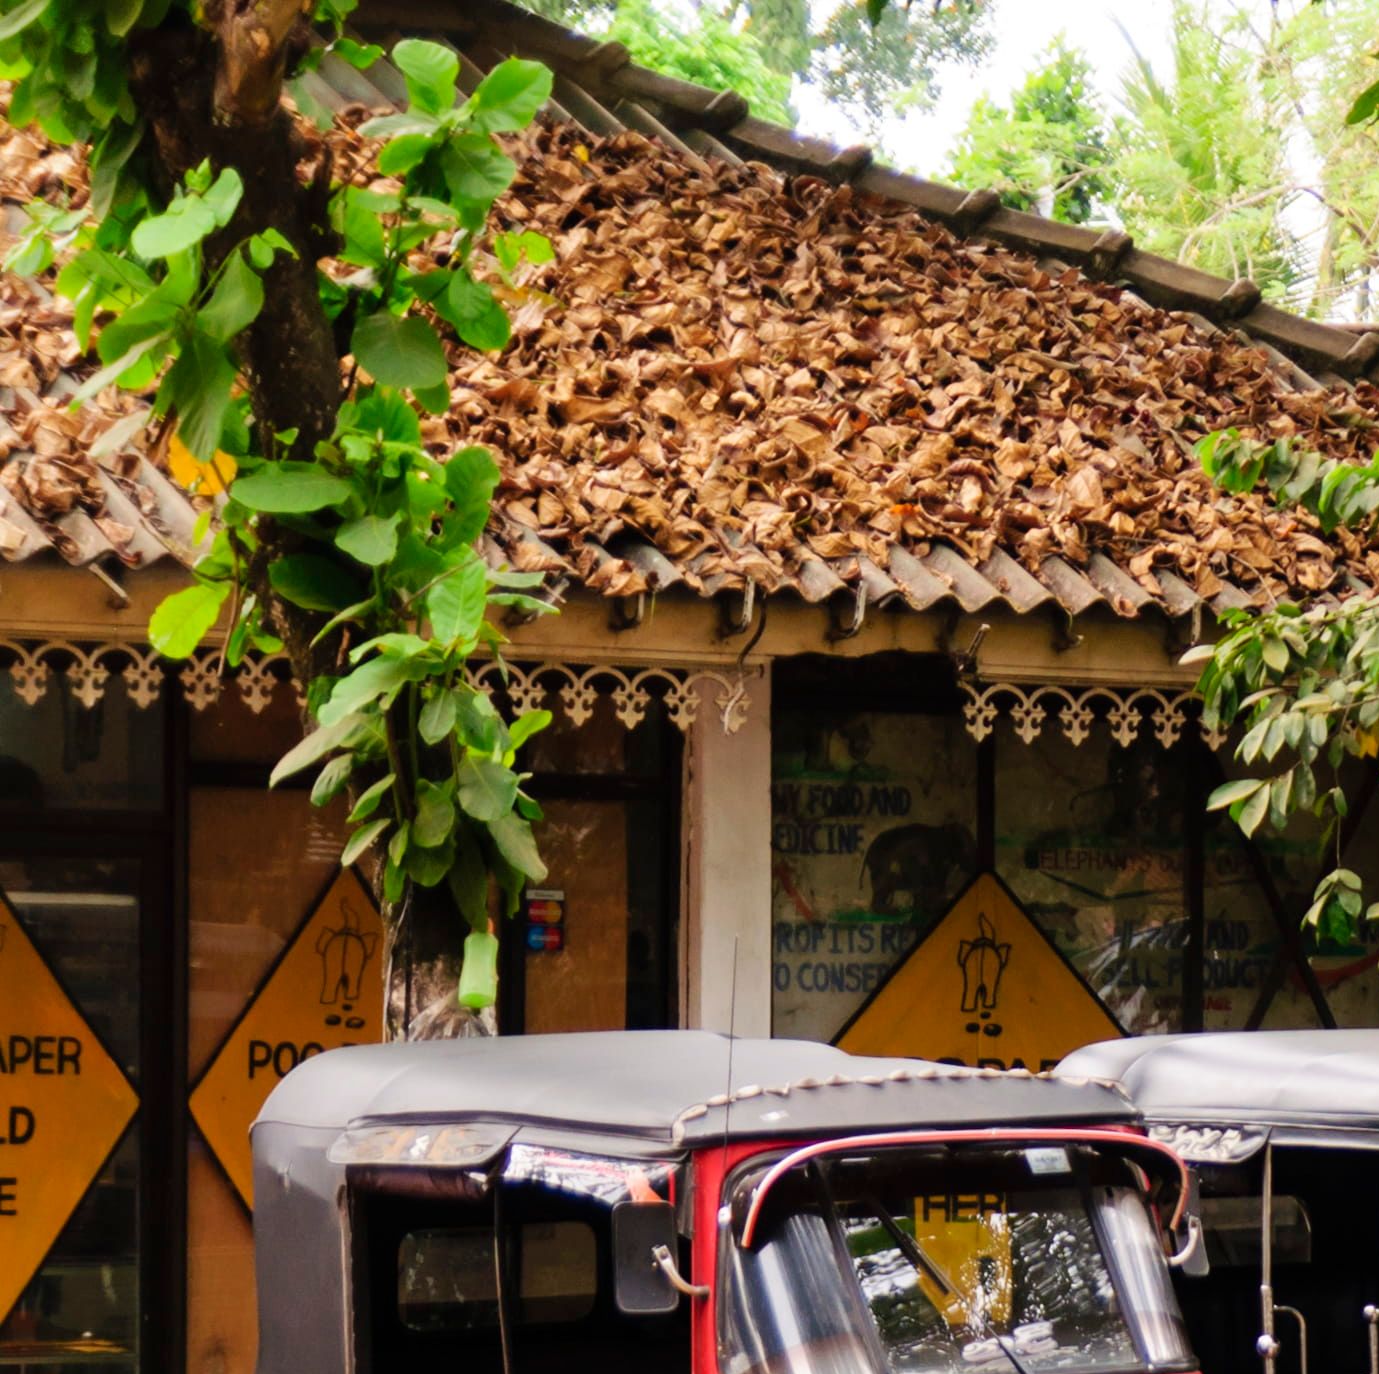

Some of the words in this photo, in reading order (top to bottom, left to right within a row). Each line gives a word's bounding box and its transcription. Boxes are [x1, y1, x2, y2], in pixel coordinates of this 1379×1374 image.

[866, 785, 913, 817] AND
[776, 823, 864, 855] EDICINE
[775, 921, 875, 954] ROFITS
[774, 961, 791, 992] O
